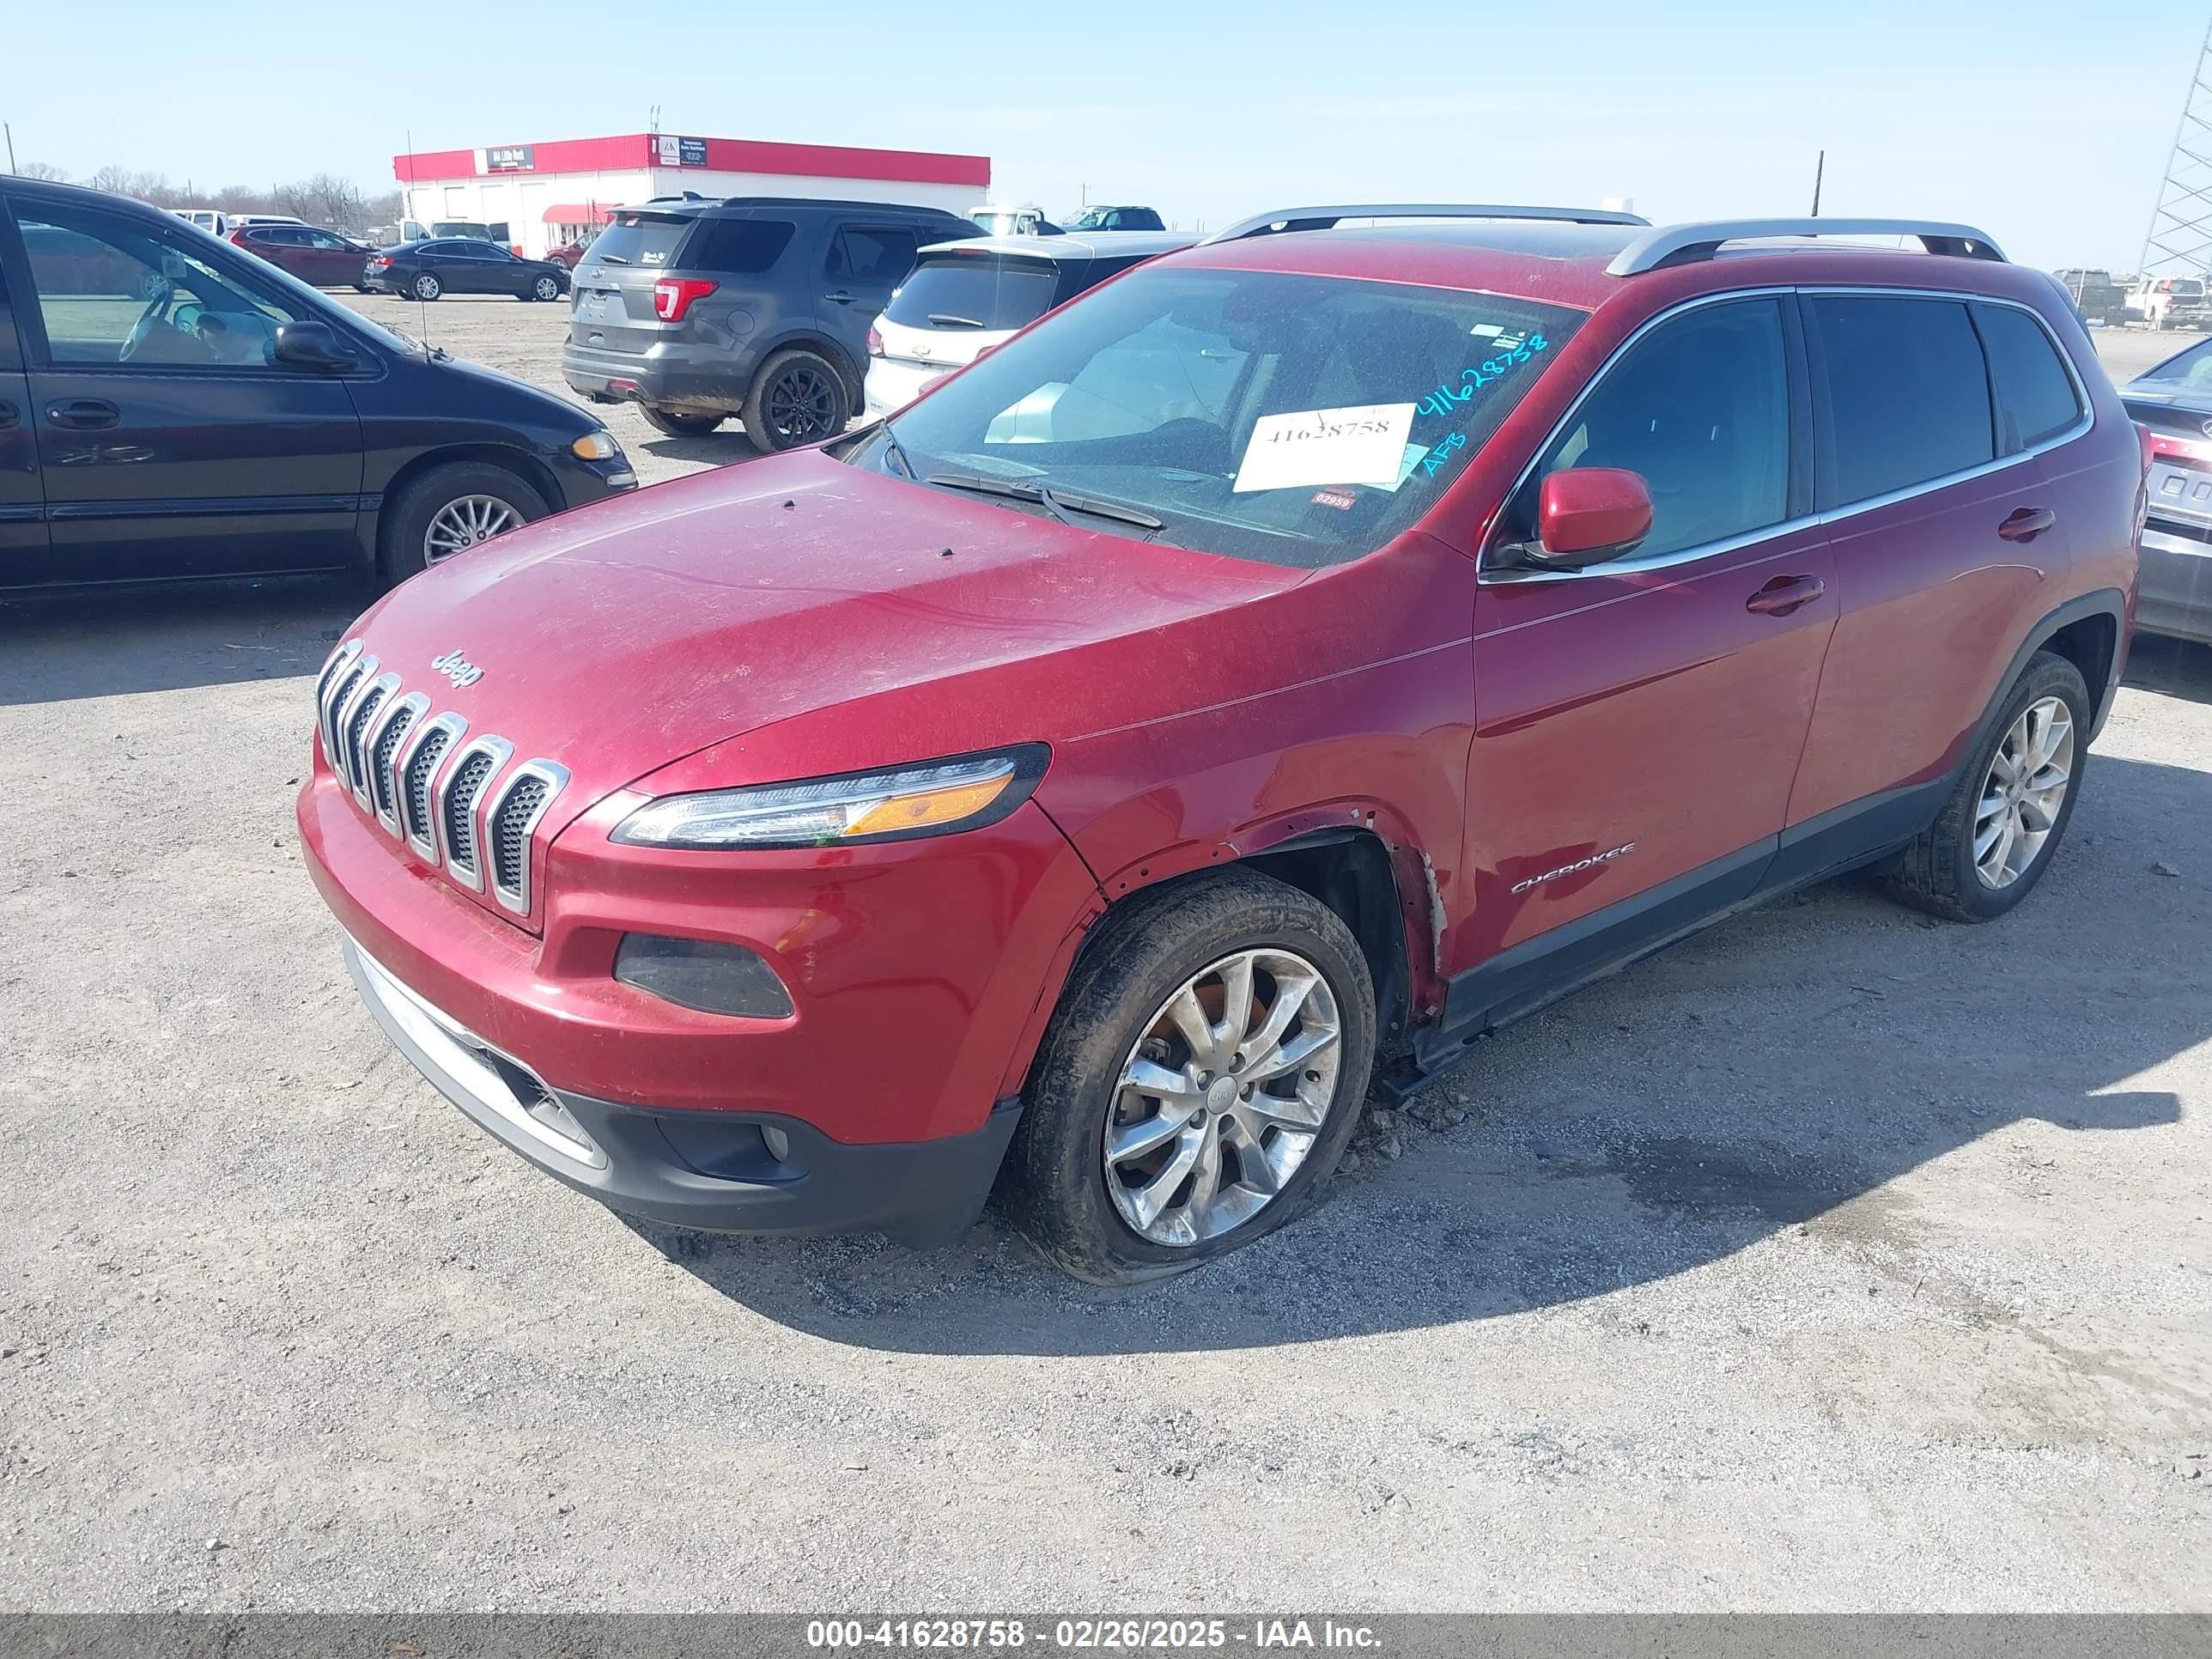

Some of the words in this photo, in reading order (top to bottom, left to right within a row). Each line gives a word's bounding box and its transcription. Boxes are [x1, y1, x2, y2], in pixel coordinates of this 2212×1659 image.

[1417, 334, 1548, 416] 41628758
[1267, 421, 1389, 443] 41628758
[1422, 432, 1467, 477] AFB
[1316, 493, 1352, 507] 02959
[431, 648, 484, 690] Jeep
[1510, 842, 1636, 894] CHEROKEE
